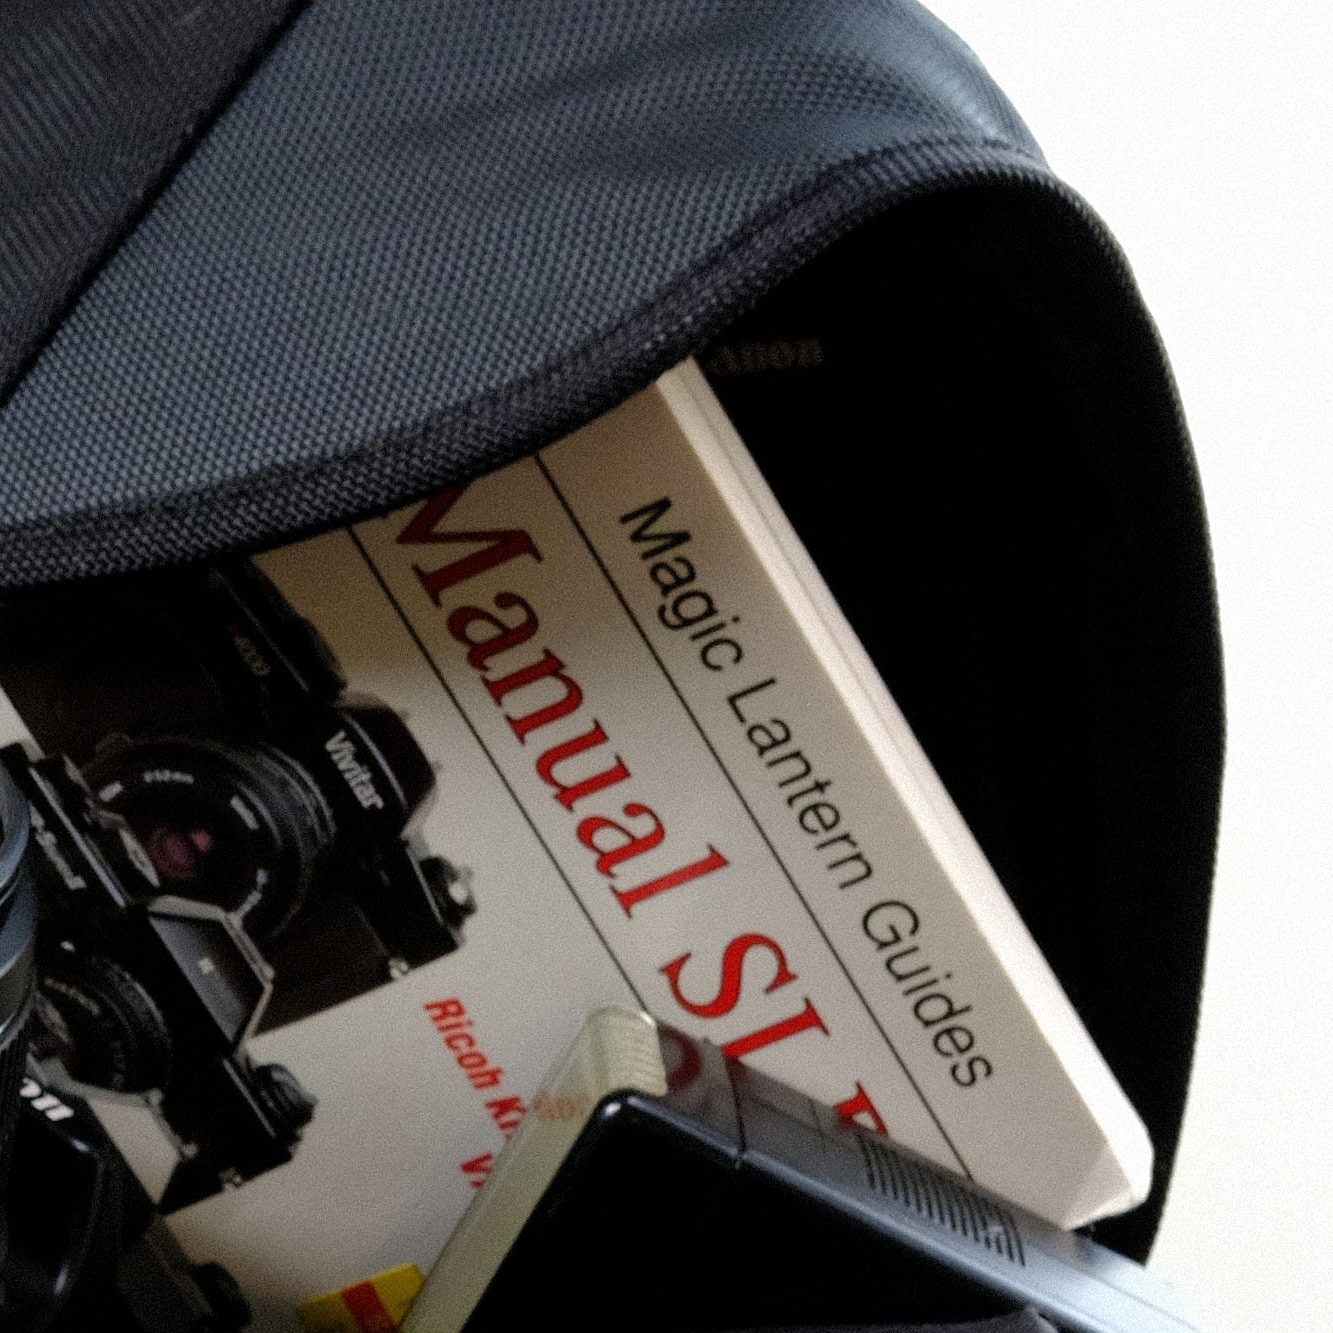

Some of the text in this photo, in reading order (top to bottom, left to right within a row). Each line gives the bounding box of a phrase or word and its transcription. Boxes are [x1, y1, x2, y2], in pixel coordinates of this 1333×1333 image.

[324, 731, 385, 811] Vivitar
[395, 484, 729, 919] Manual
[618, 494, 995, 1089] Magic Lantern Guides
[423, 997, 503, 1090] Ricoh
